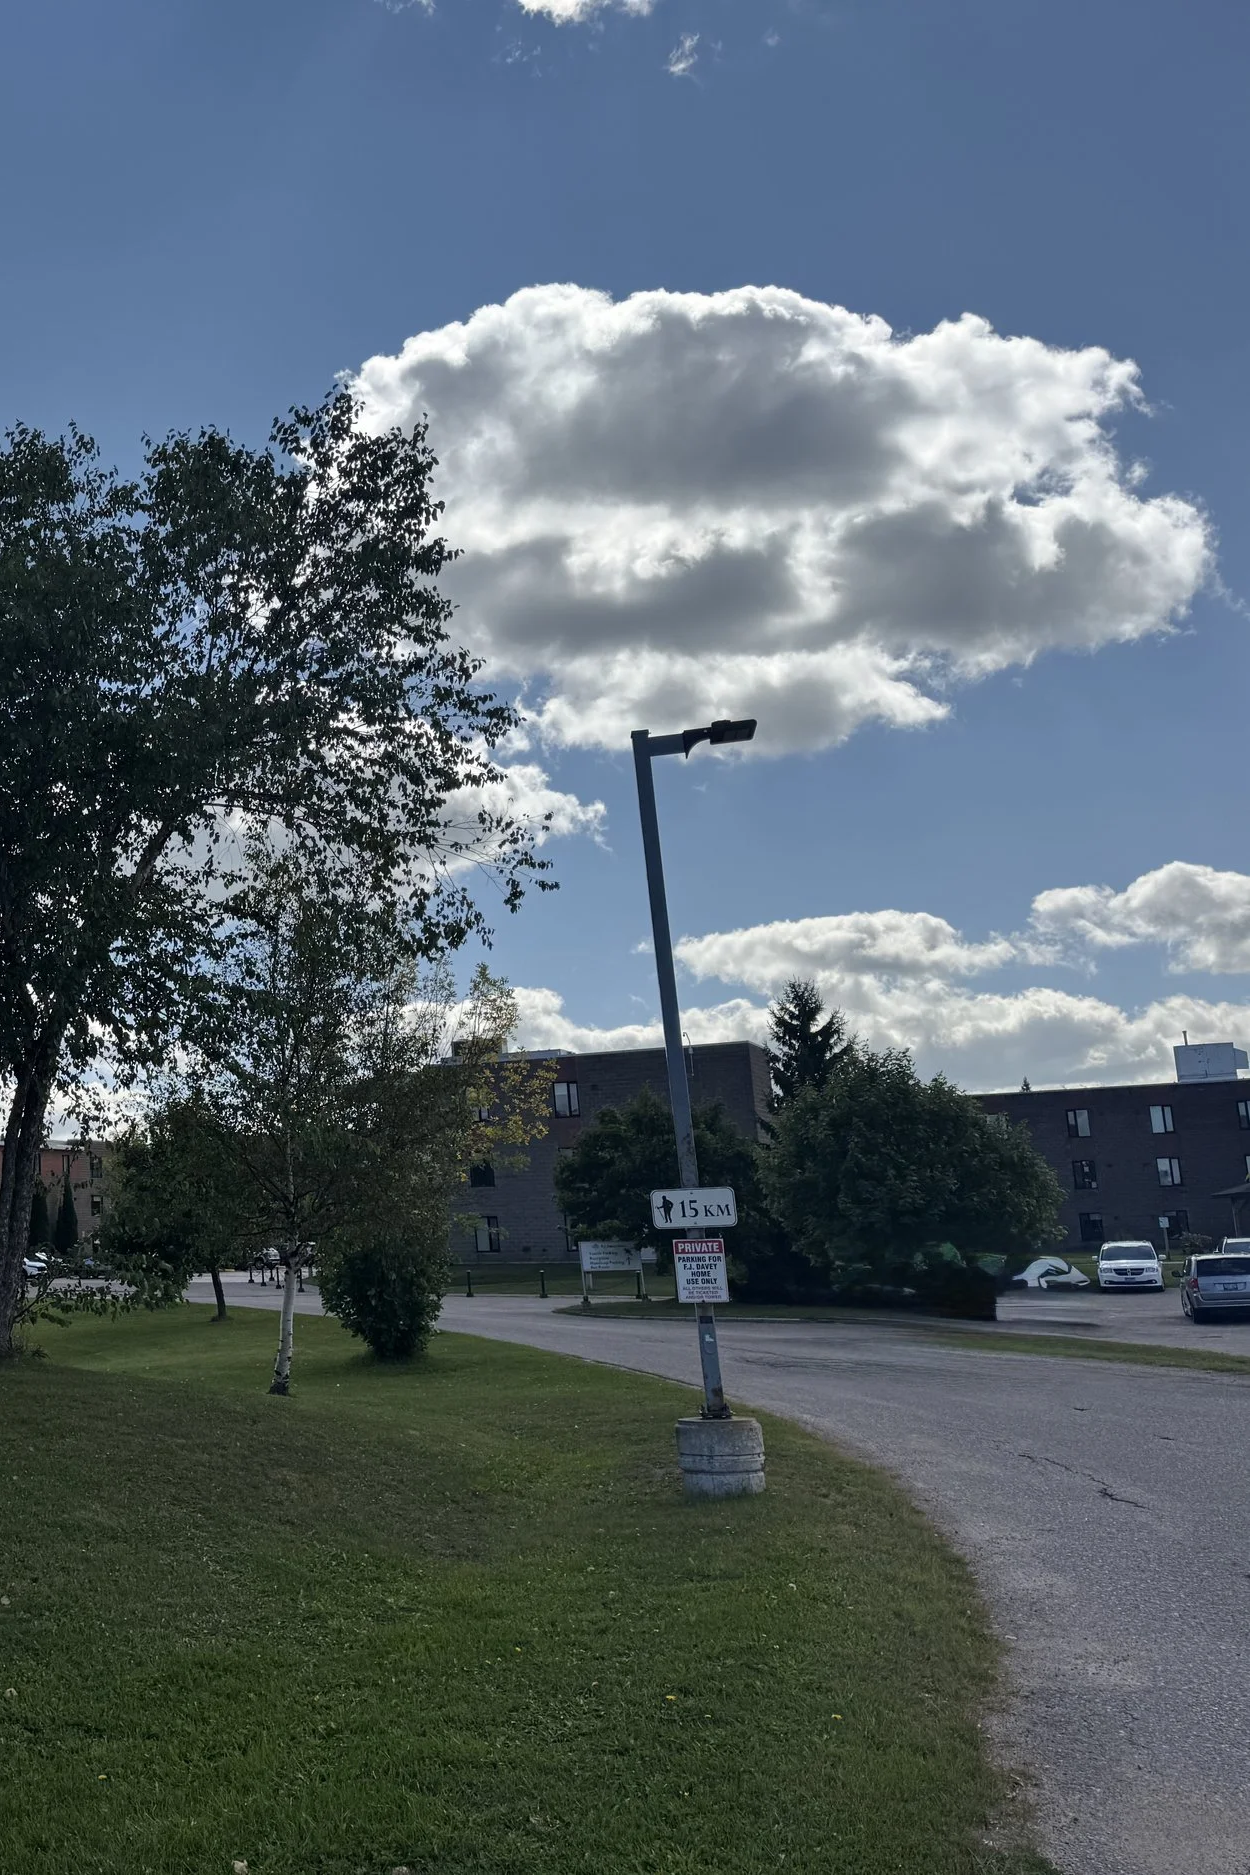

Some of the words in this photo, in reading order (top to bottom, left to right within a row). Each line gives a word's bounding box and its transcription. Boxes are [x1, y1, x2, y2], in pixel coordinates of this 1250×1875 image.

[679, 1199, 699, 1218] 15
[703, 1203, 732, 1217] KM
[678, 1243, 719, 1253] PRIVATE
